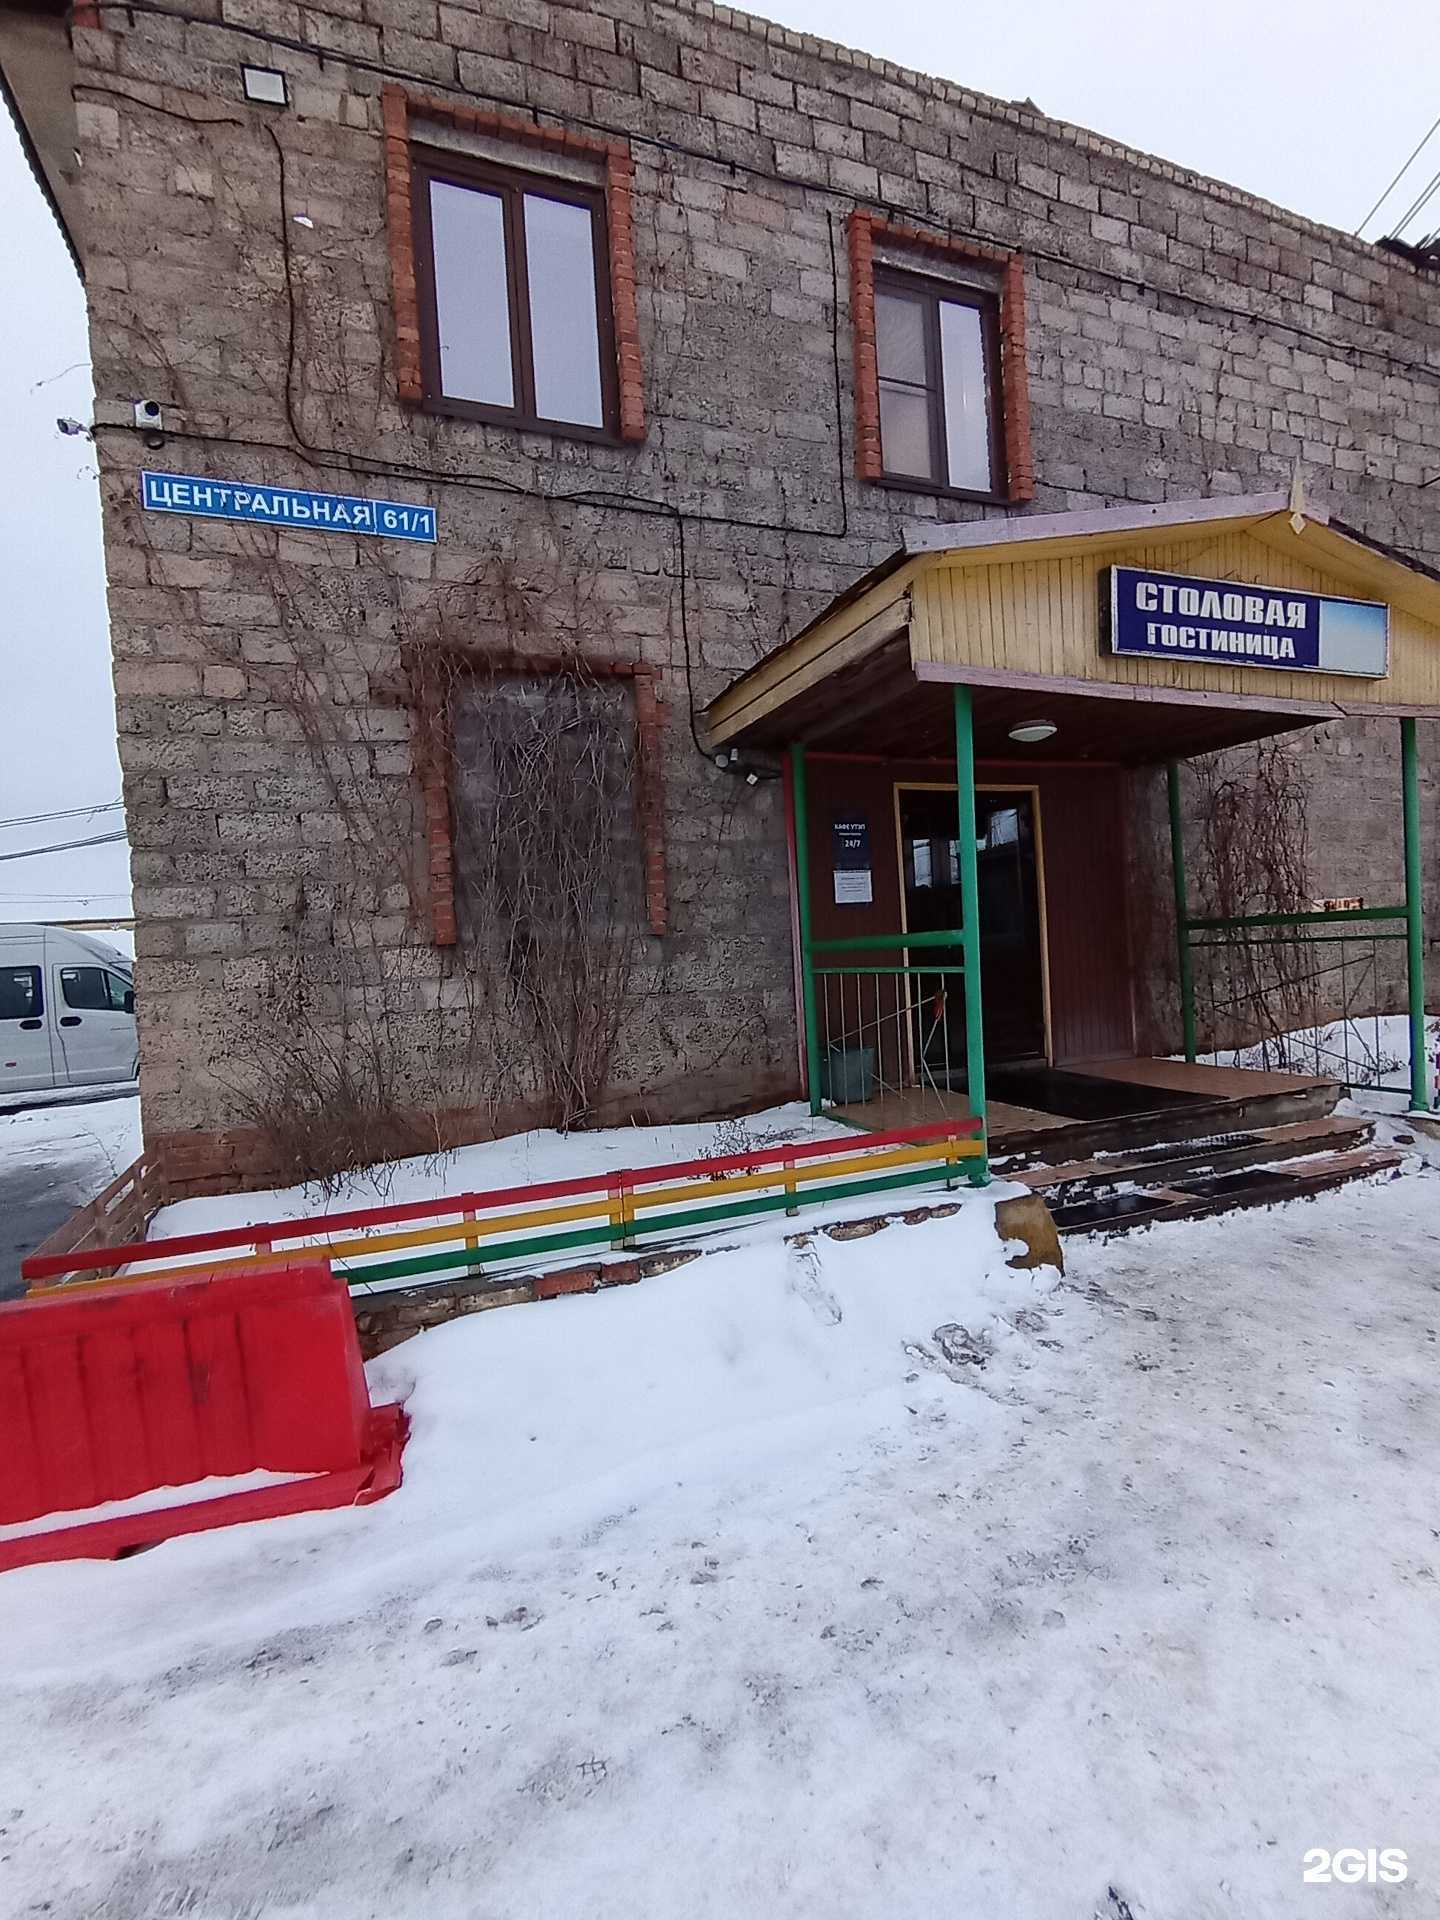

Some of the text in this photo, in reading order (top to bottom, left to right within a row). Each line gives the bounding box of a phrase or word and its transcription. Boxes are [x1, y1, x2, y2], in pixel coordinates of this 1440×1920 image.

[150, 480, 431, 534] ЦЕНТРАЛЬНАЯ 61/1
[1136, 581, 1306, 629] СТОЛОВАЯ
[1147, 622, 1296, 660] ГОСТИНИЦА
[845, 840, 861, 848] 24/7
